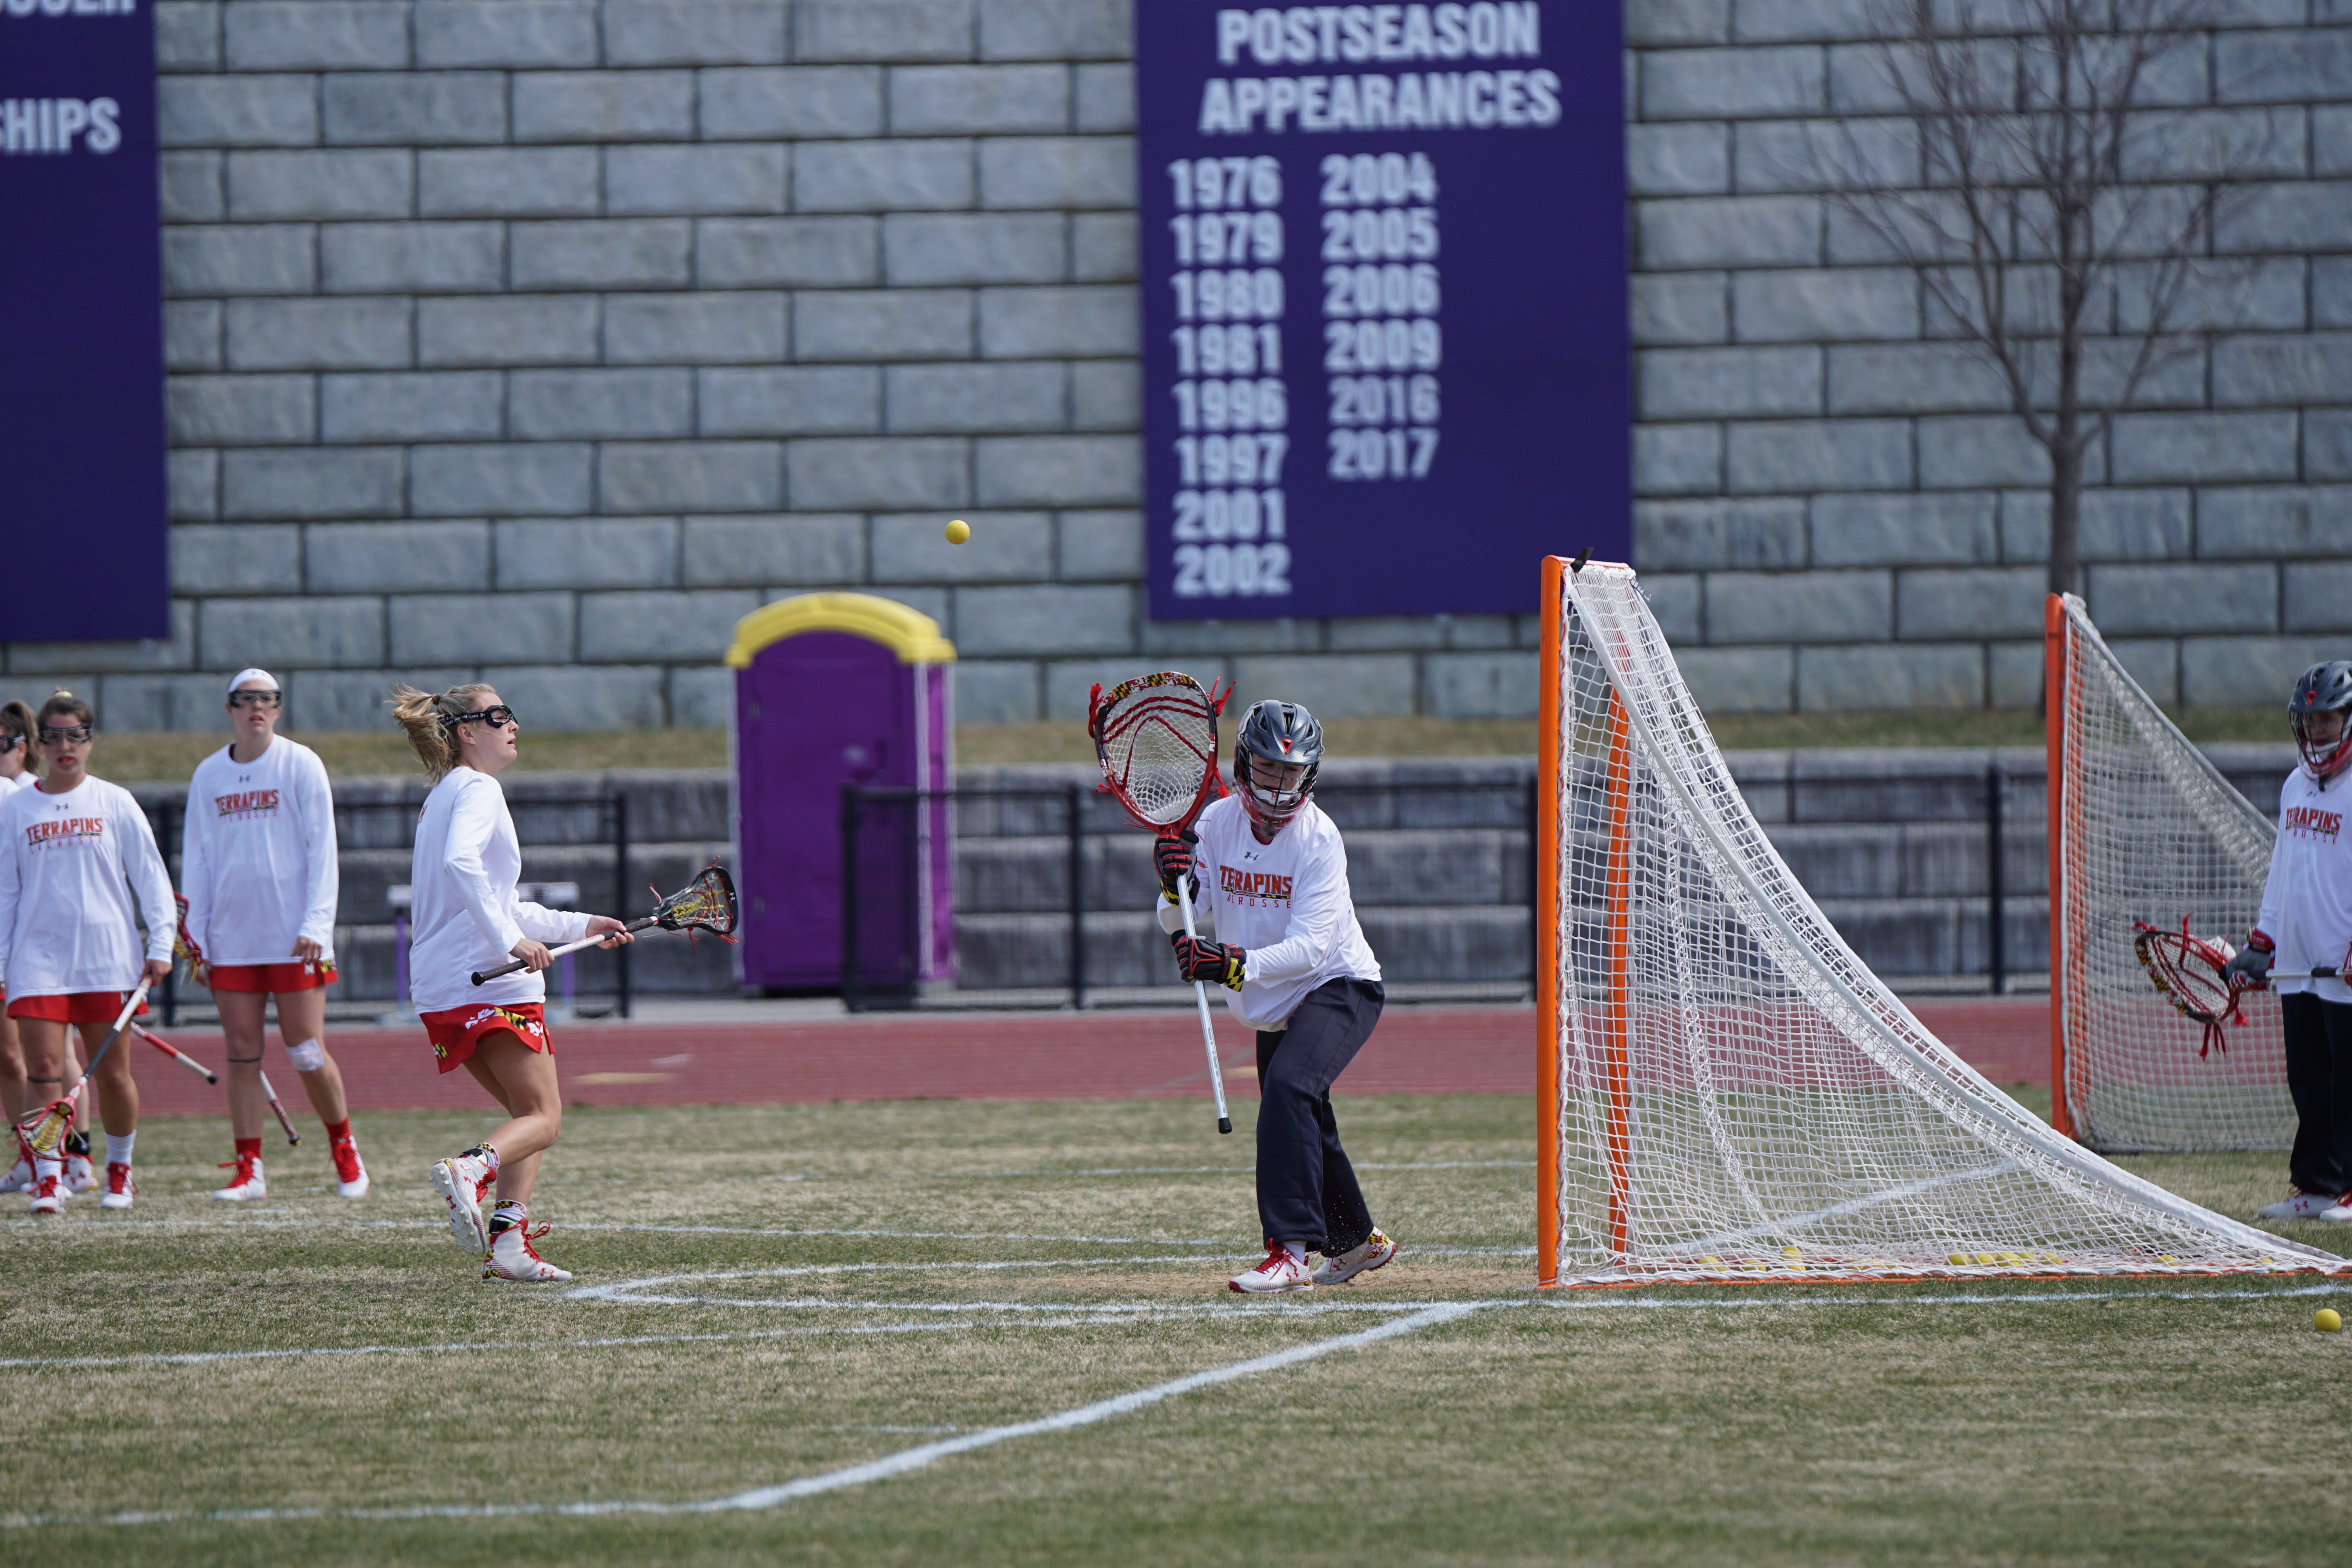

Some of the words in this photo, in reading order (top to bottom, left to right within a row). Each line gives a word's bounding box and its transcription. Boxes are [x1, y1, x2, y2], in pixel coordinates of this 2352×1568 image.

[1217, 1, 1540, 65] POSTSEASON
[0, 97, 120, 153] HIPS
[1199, 69, 1561, 134] APPEARANCES
[1168, 156, 1282, 209] 1976
[1319, 153, 1438, 205] 2004
[1169, 212, 1284, 264] 1979
[1321, 208, 1439, 261] 2005
[1170, 269, 1285, 320] 1980
[1322, 263, 1440, 317] 2006
[1171, 323, 1281, 375] 1981
[1324, 319, 1441, 372] 2009
[1172, 379, 1287, 430] 1996
[1328, 375, 1440, 424] 2016
[1174, 433, 1288, 485] 1997
[1328, 428, 1439, 478] 2017
[1172, 488, 1286, 541] 2001
[1172, 543, 1291, 595] 2002
[214, 789, 279, 811] TERRAPINS
[25, 817, 102, 842] TERRAPINS
[1220, 865, 1292, 895] TERAPINS
[1227, 893, 1291, 909] ACROSSE
